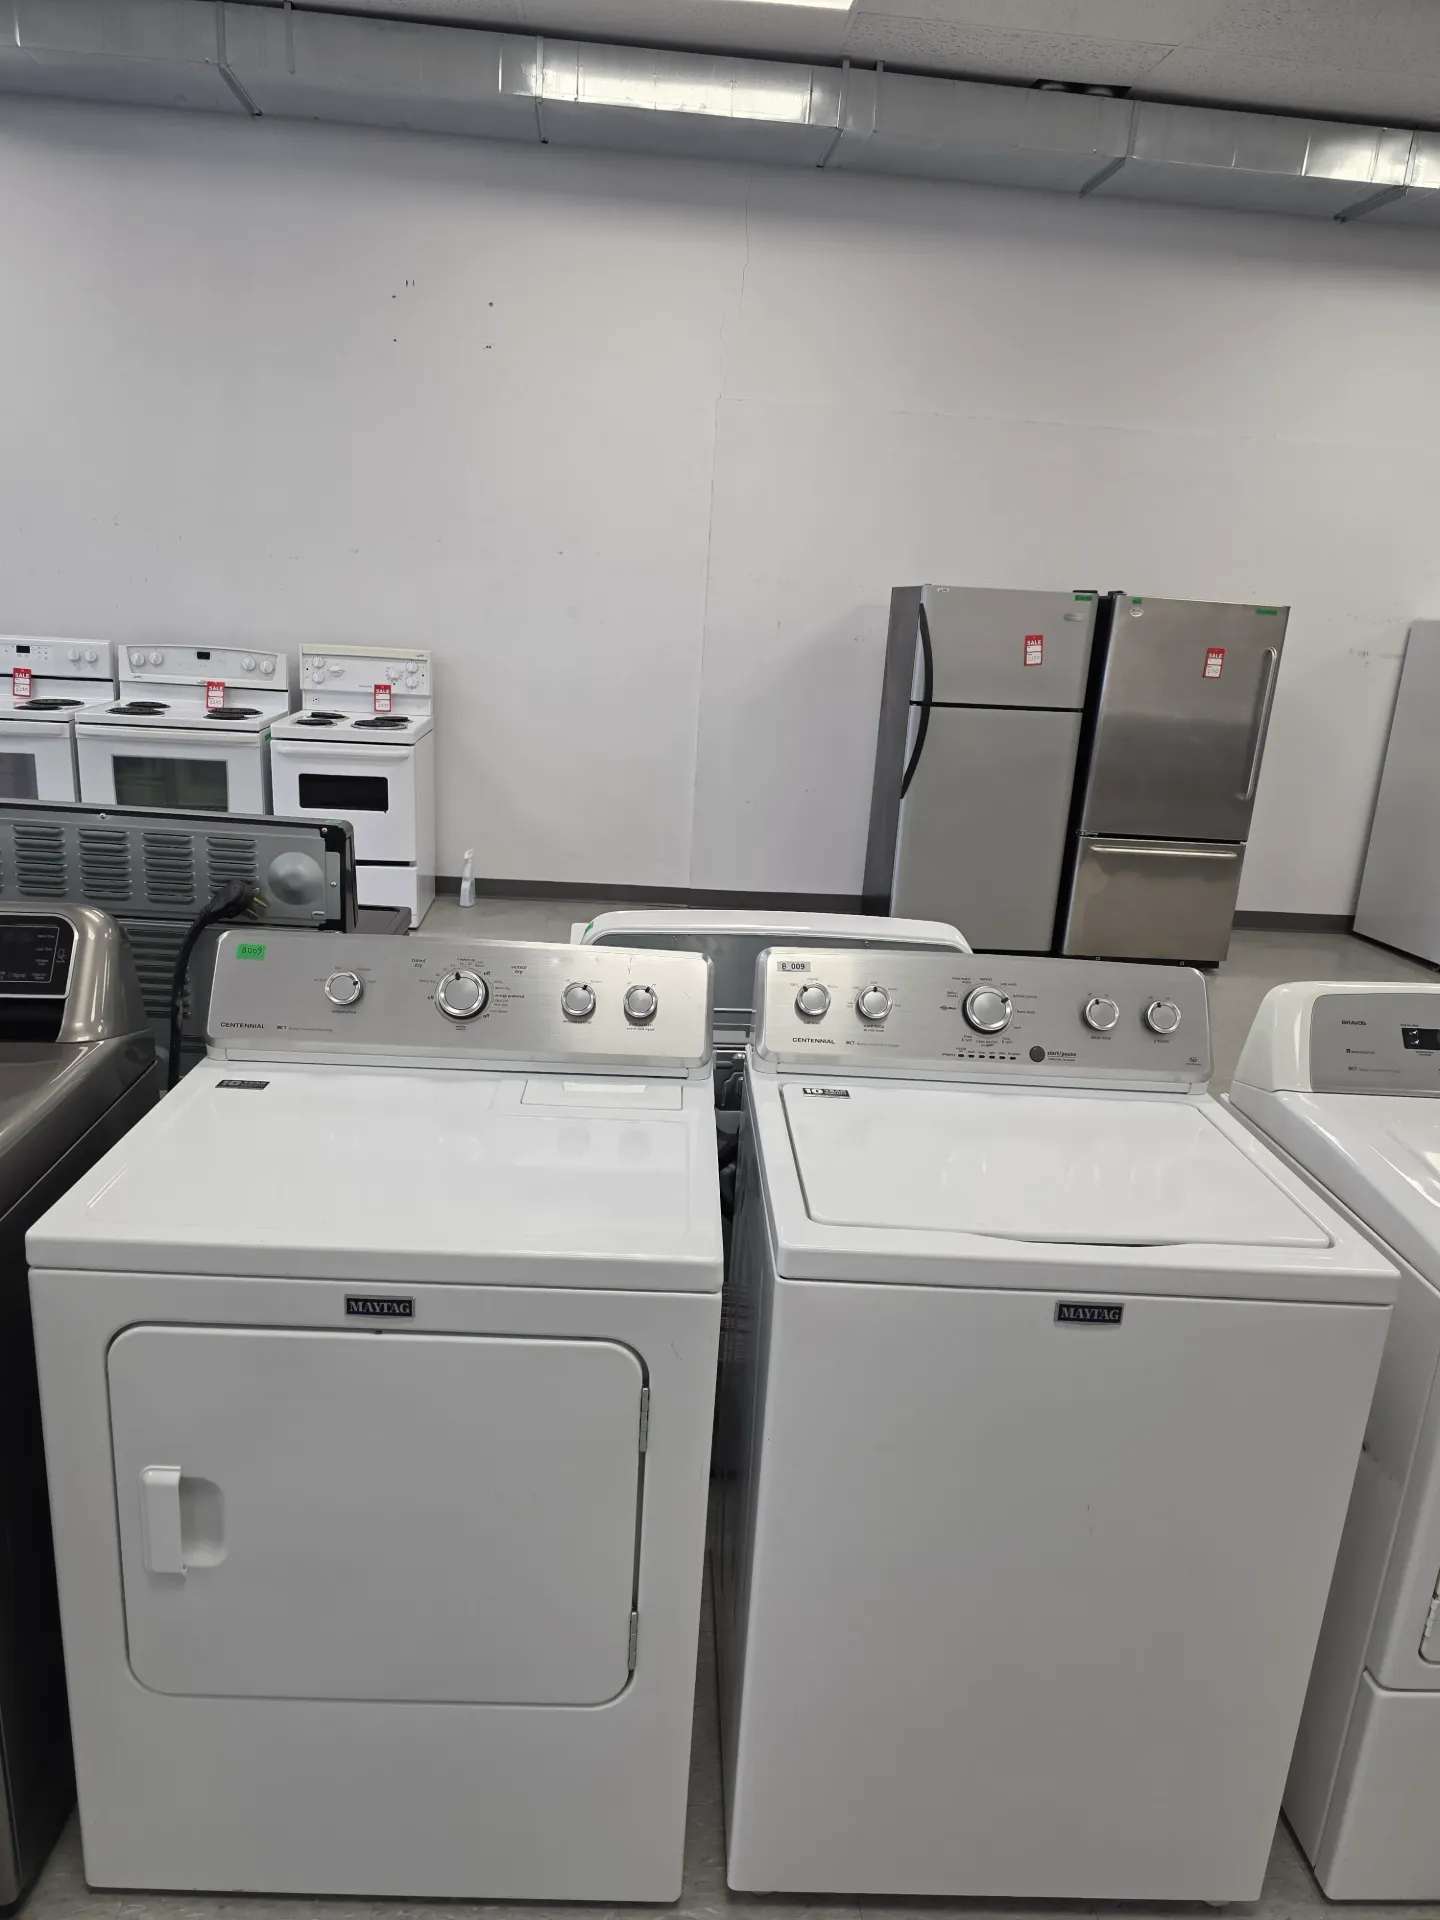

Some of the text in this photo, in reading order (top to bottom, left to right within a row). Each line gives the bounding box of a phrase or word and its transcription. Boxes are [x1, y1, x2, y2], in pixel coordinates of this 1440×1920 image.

[220, 1021, 265, 1029] CENTENNIAL
[792, 1037, 836, 1045] CENTENNIAL
[348, 1301, 410, 1313] MAYTAG
[1060, 1307, 1120, 1320] MAYTAG
